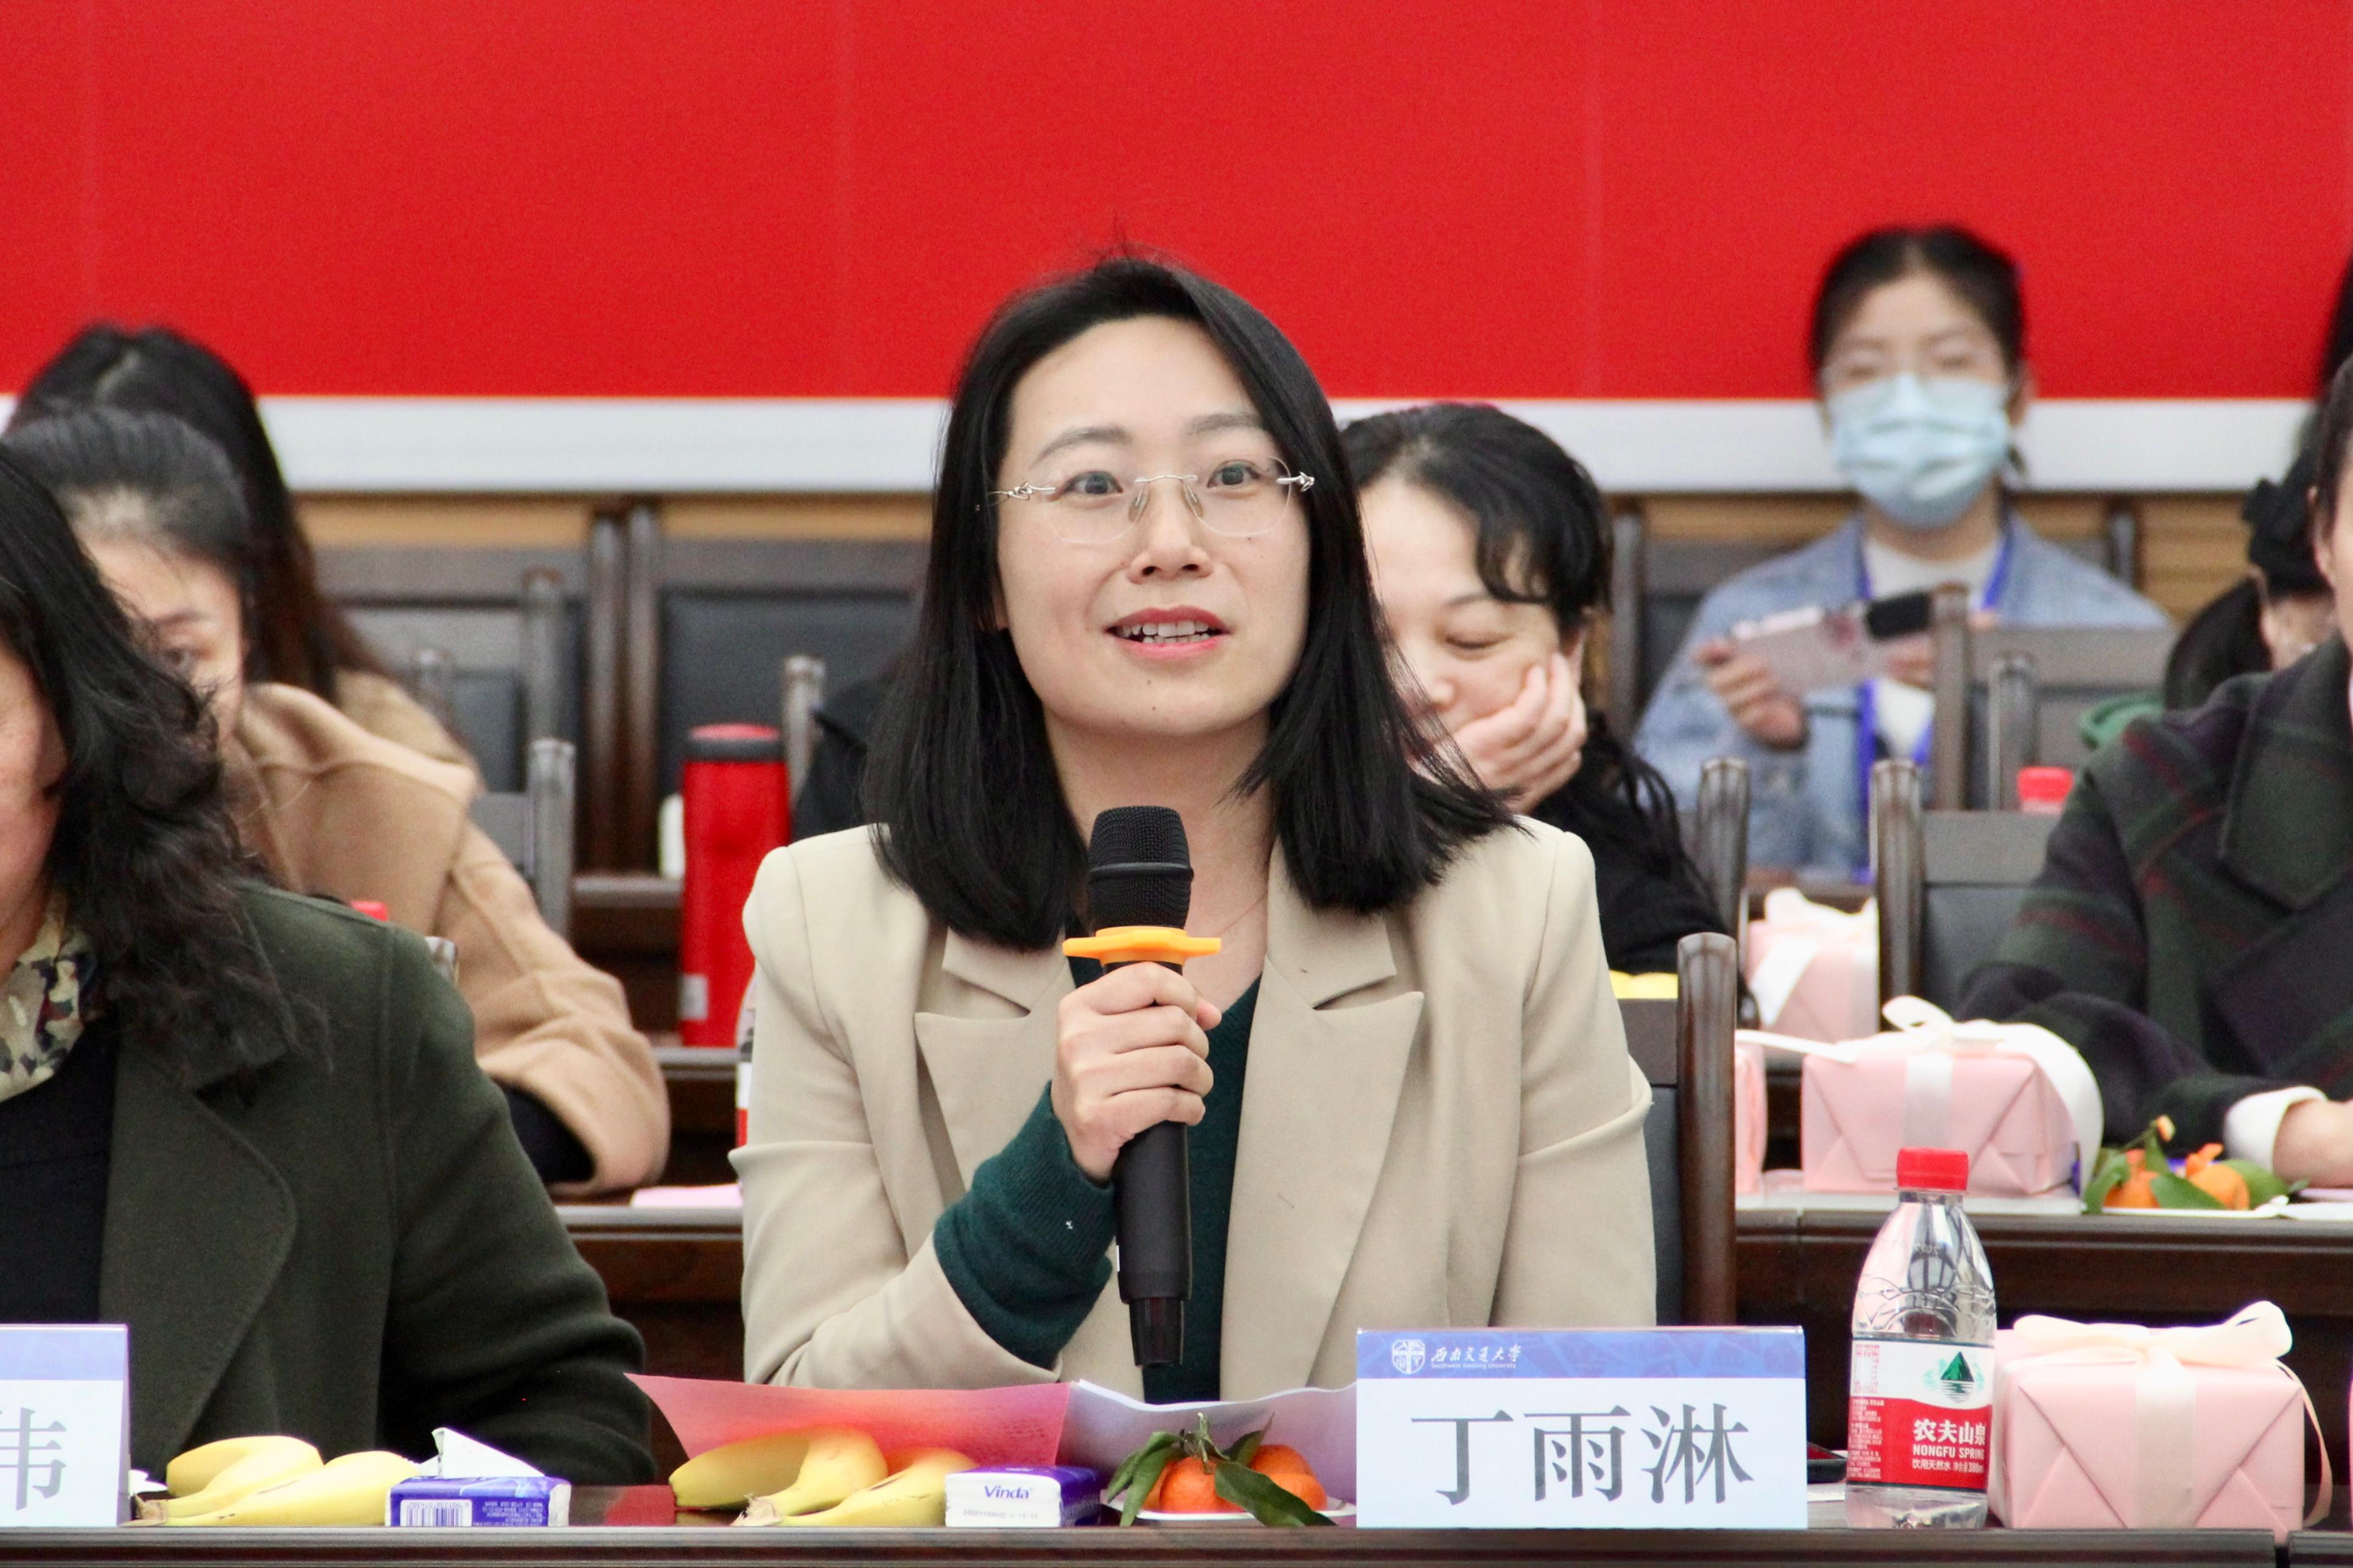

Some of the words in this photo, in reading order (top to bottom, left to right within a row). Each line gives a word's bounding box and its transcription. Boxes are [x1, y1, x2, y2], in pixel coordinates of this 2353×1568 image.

[1912, 1418, 1986, 1446] 农夫山泉
[1410, 1402, 1753, 1505] 丁雨淋
[1912, 1444, 1956, 1458] NONGFU
[1959, 1447, 1985, 1460] SPRING
[1912, 1458, 1951, 1471] 饮用天然水
[984, 1486, 1029, 1499] Vinda
